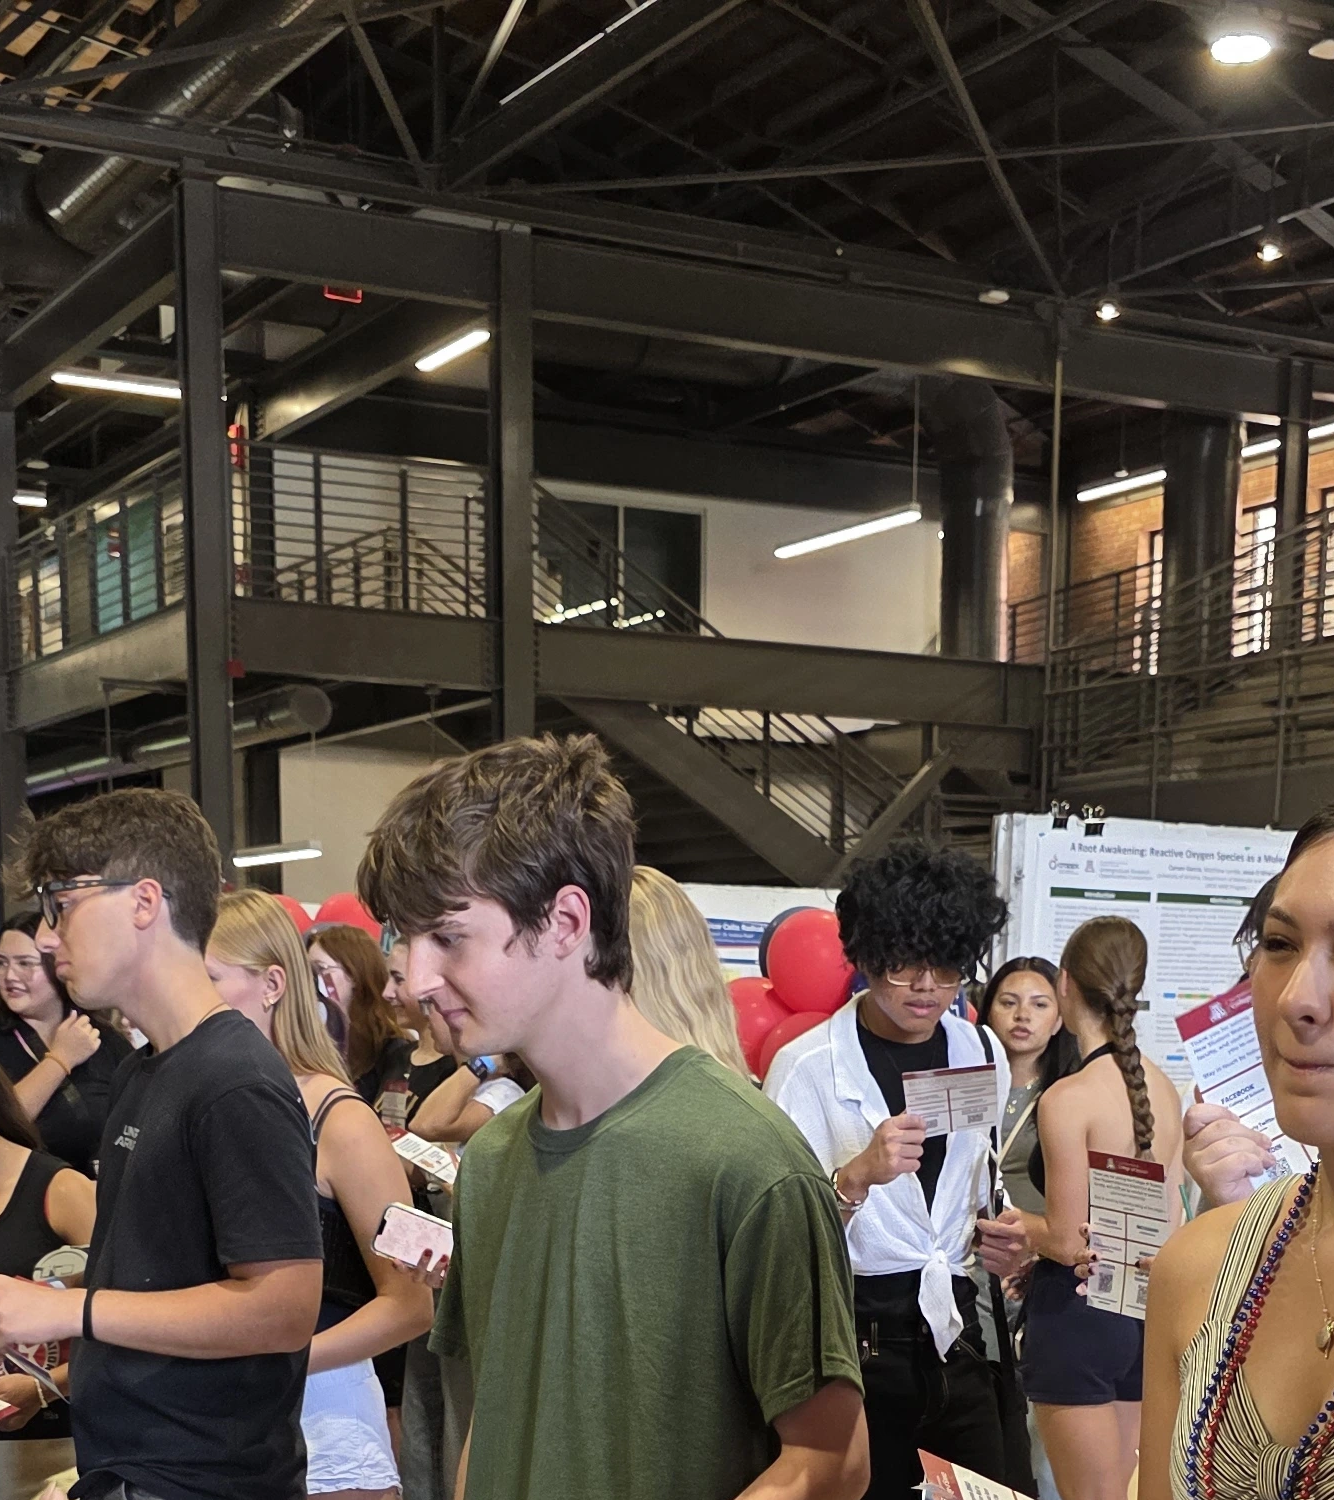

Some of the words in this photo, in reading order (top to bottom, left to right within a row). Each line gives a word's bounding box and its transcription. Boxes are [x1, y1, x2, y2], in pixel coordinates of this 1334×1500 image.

[1078, 843, 1098, 854] Root
[1099, 845, 1148, 858] Awakening:
[1150, 848, 1184, 859] Reactive
[1219, 1083, 1255, 1104] FACEBOOK
